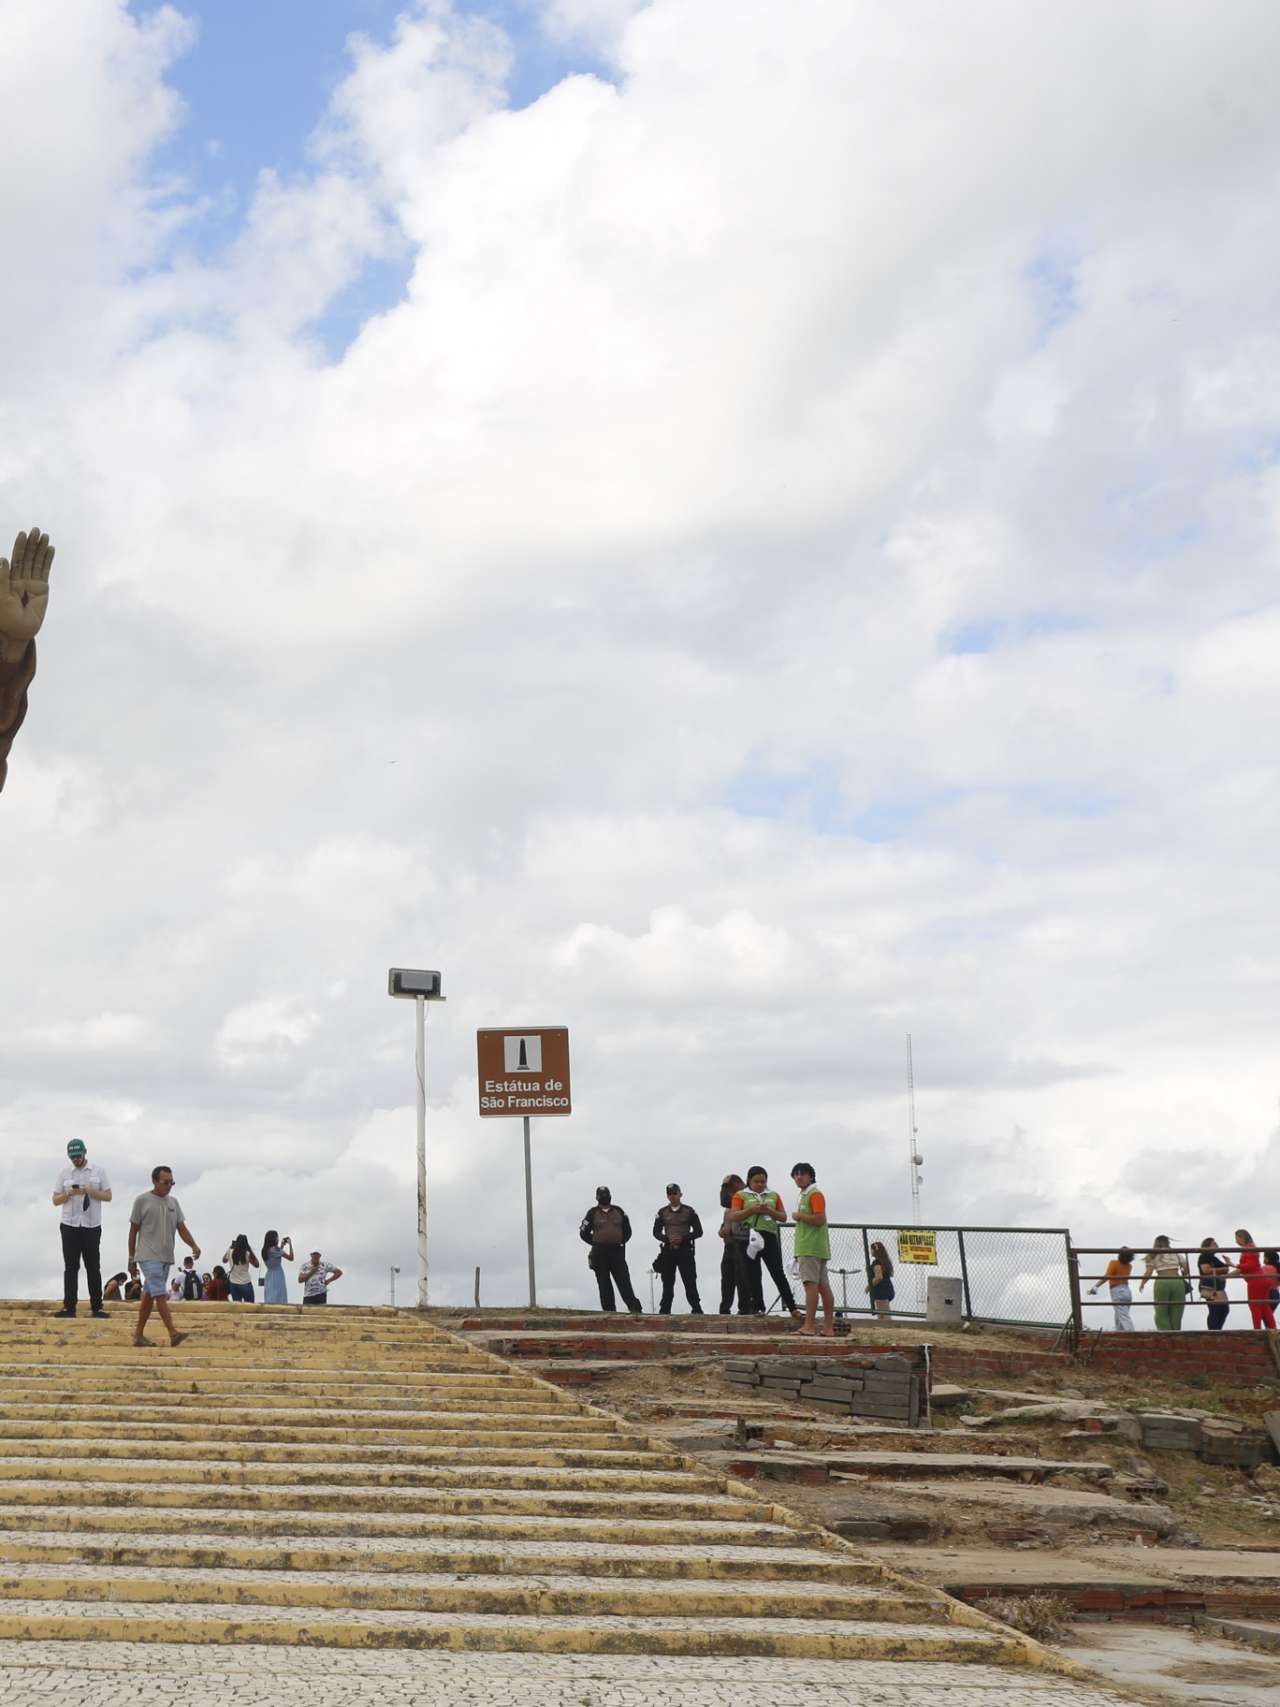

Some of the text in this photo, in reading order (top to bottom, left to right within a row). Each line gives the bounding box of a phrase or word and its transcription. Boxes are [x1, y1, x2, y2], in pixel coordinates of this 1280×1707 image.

[485, 1079, 562, 1093] Estátua de
[480, 1095, 569, 1109] São Francisco
